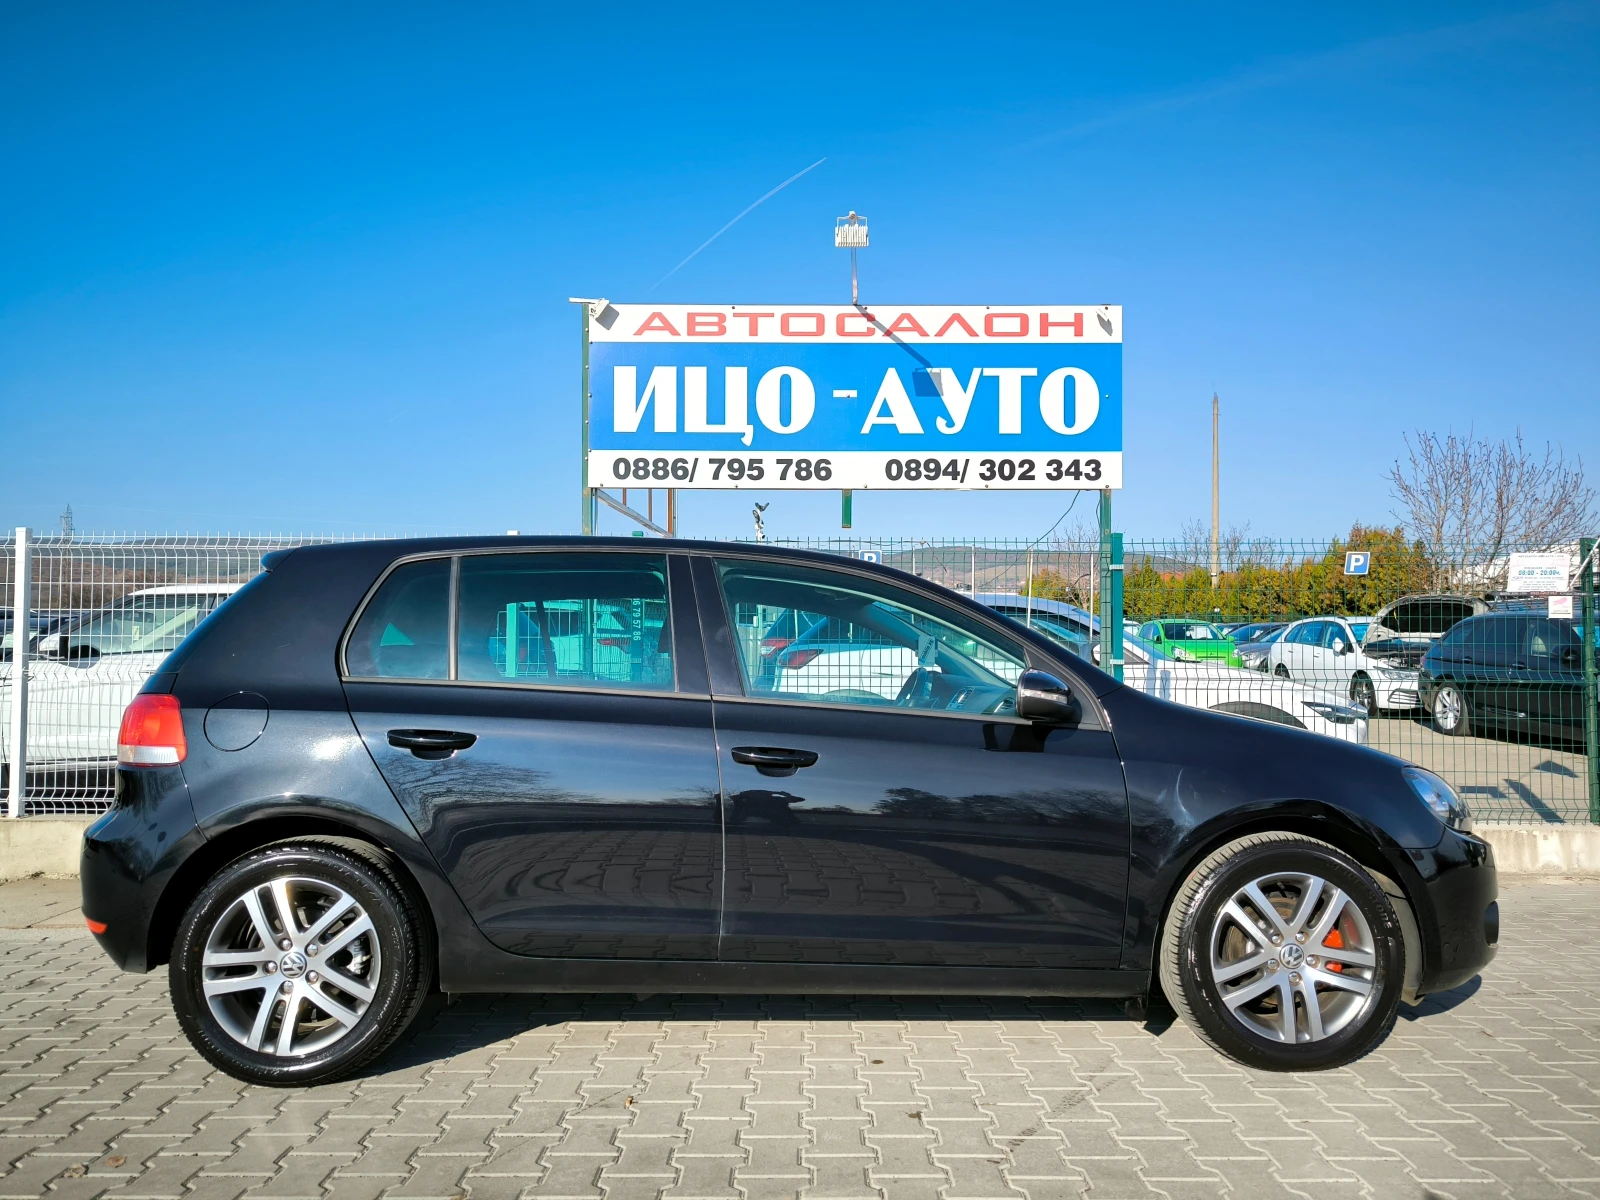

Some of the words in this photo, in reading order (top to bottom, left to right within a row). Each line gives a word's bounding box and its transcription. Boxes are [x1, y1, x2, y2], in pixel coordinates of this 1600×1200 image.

[633, 312, 1083, 337] АВТОСАЛОН
[612, 458, 699, 483] 0886/
[709, 458, 765, 481] 795
[776, 458, 832, 481] 786
[885, 458, 970, 483] 0894/
[979, 458, 1036, 481] 302
[1046, 458, 1102, 481] 343
